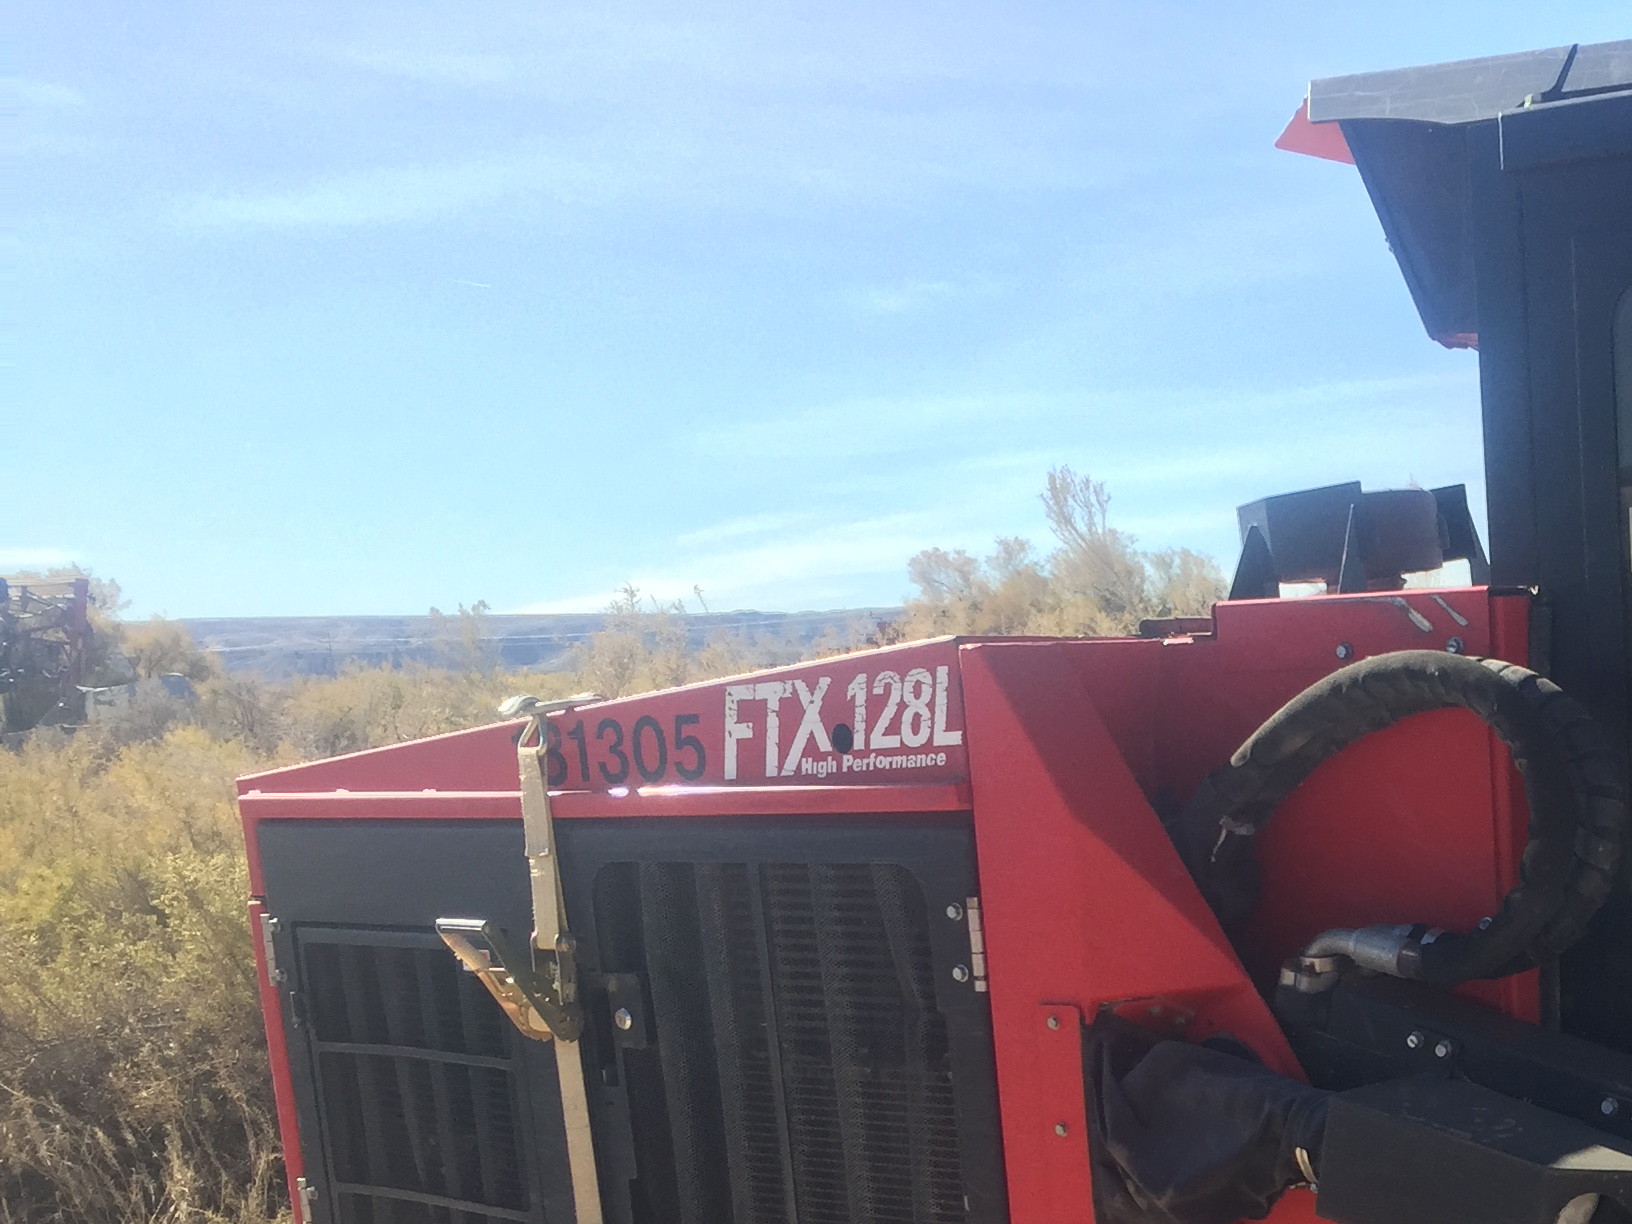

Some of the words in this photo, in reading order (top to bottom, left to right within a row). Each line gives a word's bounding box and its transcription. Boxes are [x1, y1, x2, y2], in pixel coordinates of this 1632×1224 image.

[723, 676, 834, 781] FTX
[845, 665, 963, 751] 128L
[800, 756, 840, 778] High
[842, 751, 947, 774] Performance
